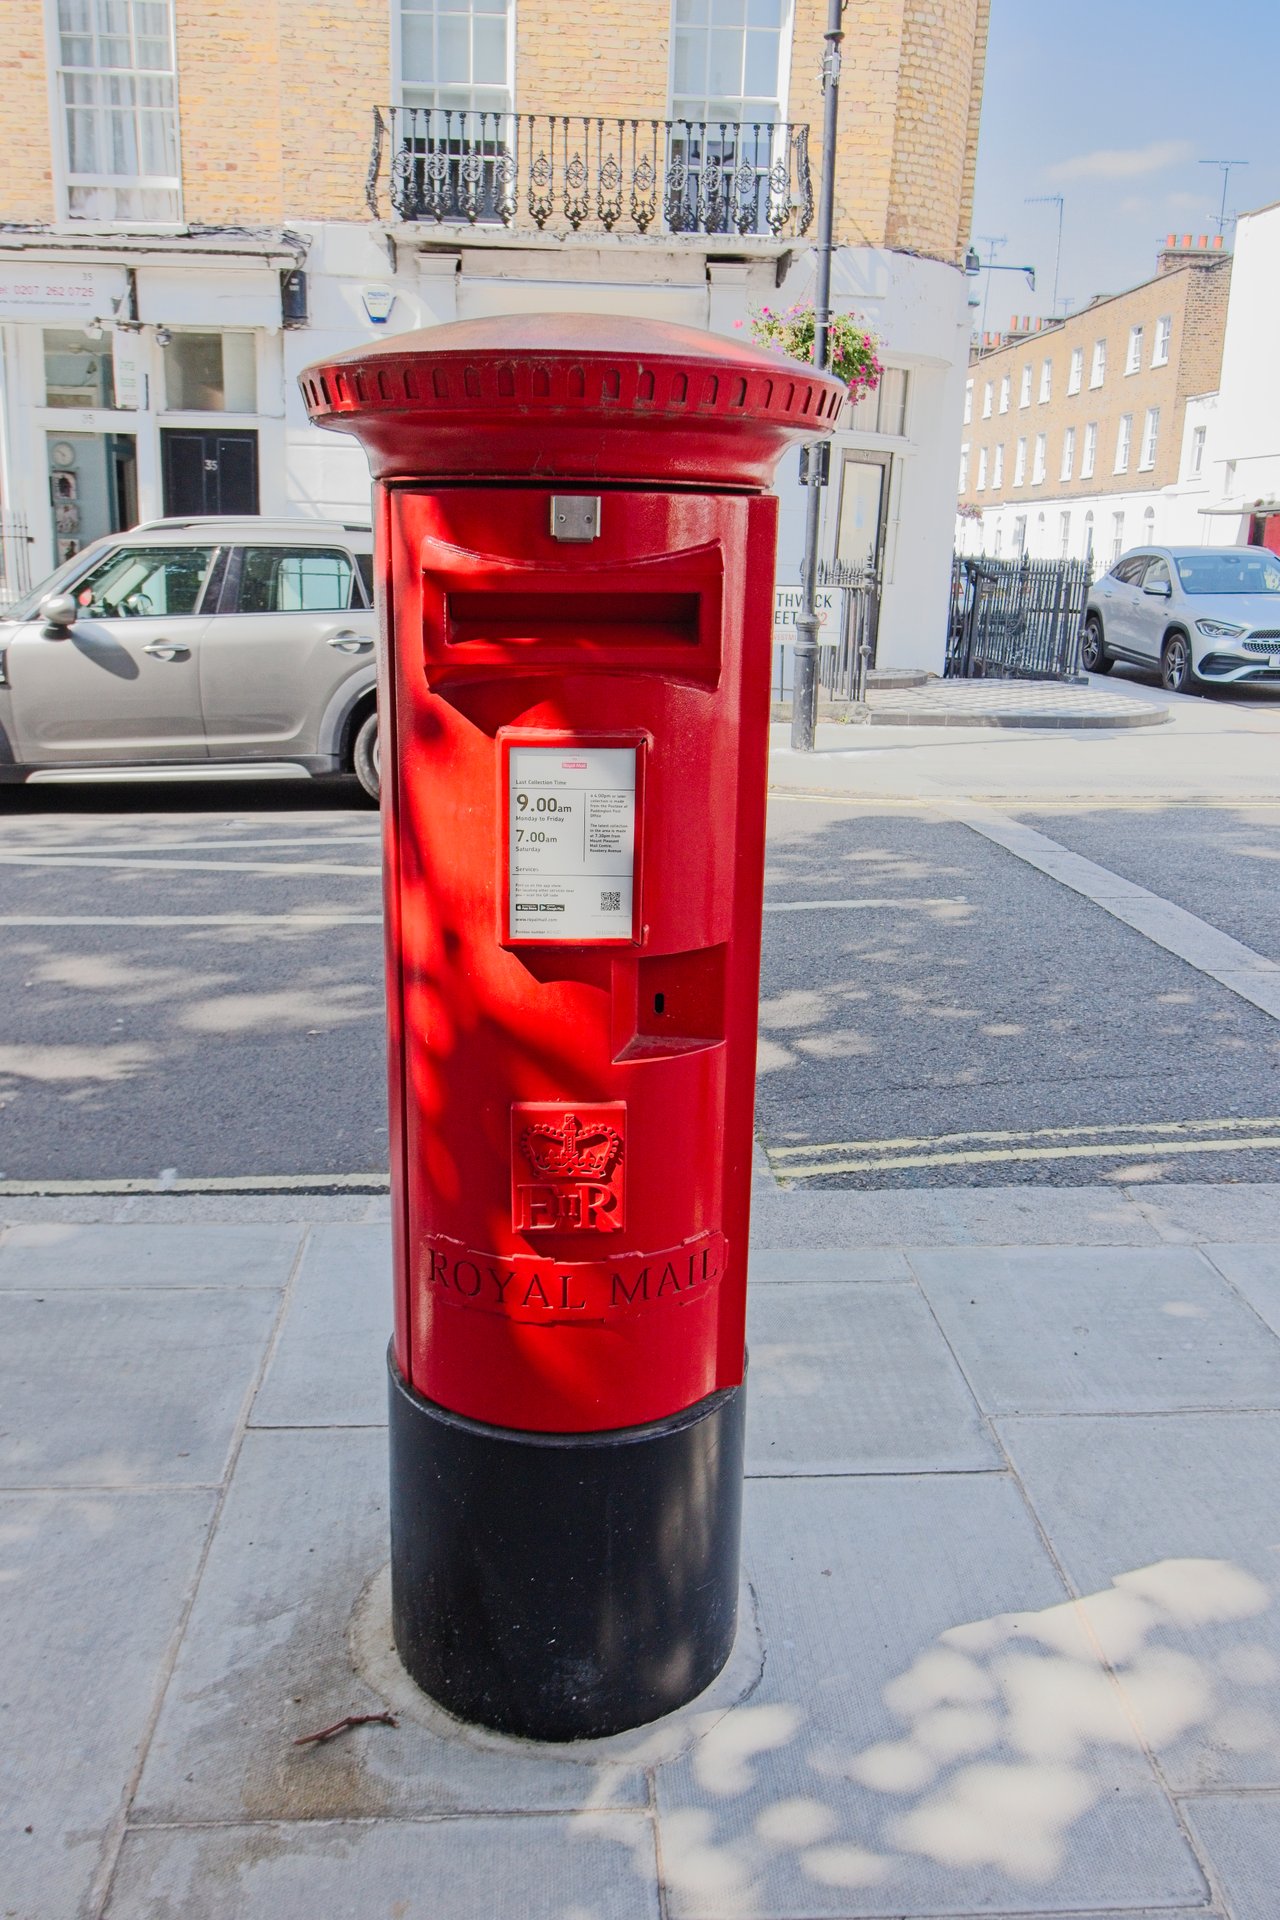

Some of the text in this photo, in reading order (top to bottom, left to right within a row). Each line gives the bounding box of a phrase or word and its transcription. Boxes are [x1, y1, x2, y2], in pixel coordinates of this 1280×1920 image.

[204, 459, 218, 471] 35
[777, 593, 832, 608] THWCK
[775, 611, 798, 624] EET
[516, 793, 572, 813] 9.00am
[515, 829, 557, 843] 7.00am
[427, 1247, 718, 1309] ROYAL MAIL
